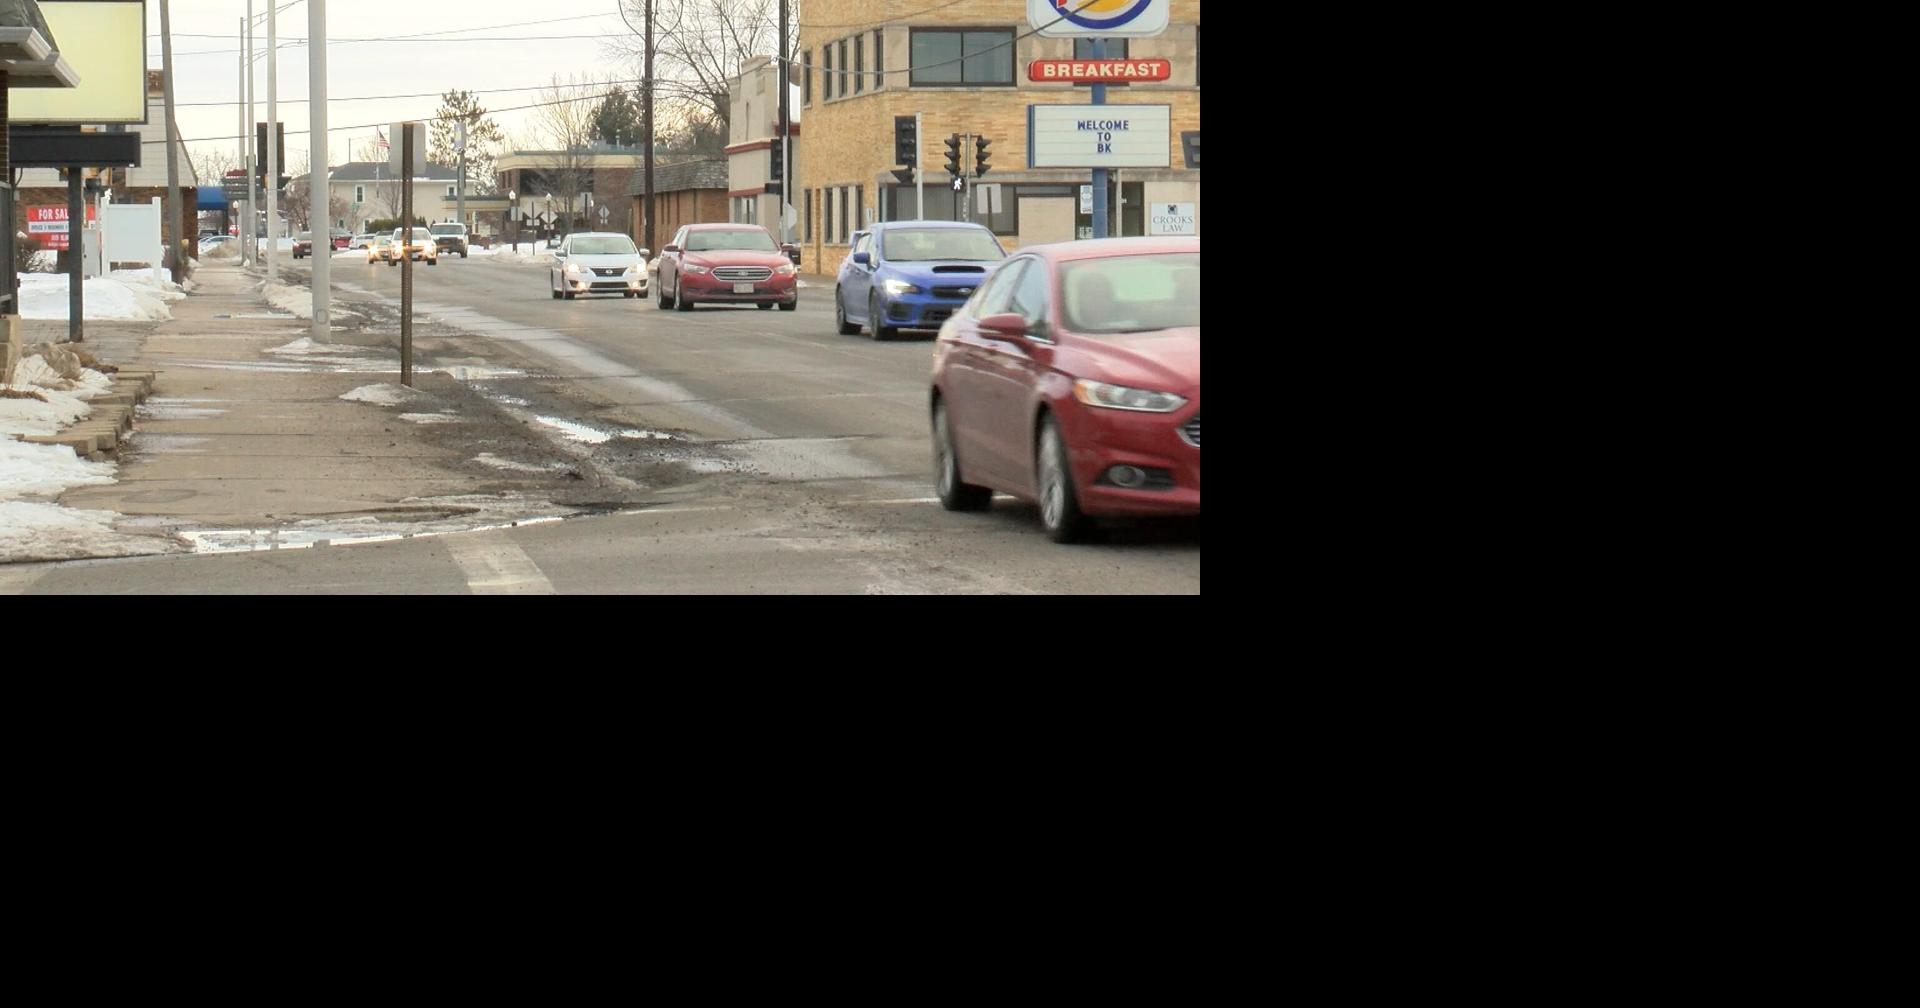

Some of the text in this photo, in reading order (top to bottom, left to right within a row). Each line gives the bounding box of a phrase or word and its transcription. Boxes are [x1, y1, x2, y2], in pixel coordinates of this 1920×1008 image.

[1043, 63, 1161, 77] BREAKFAST
[1077, 120, 1129, 130] WELCOME
[1097, 132, 1111, 141] TO
[1097, 143, 1112, 153] BK
[38, 208, 69, 220] FOR SAL
[1153, 215, 1193, 224] CROOKS
[1162, 224, 1184, 232] LAW
